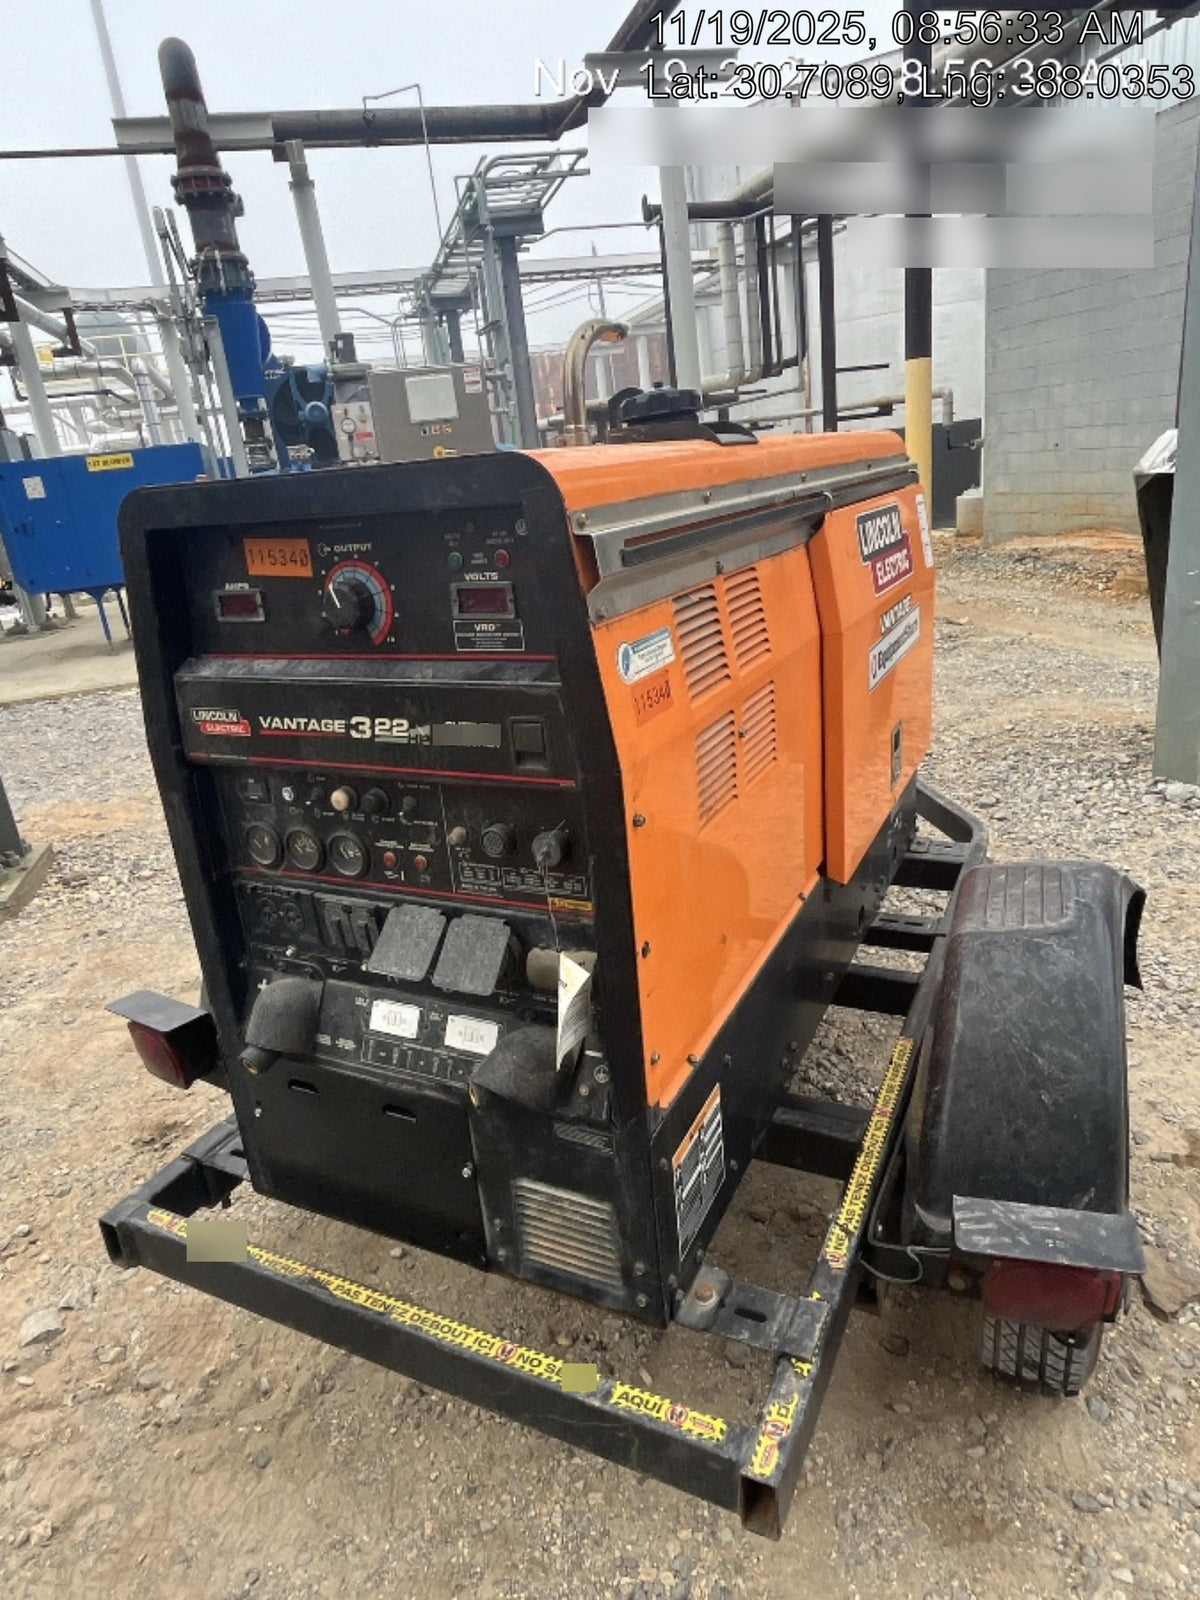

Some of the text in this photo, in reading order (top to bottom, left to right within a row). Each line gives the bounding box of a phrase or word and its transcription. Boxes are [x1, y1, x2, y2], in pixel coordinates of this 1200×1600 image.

[858, 511, 903, 556] LINCOLN
[333, 543, 373, 553] OUTPUT
[463, 572, 499, 581] VOLTS
[875, 548, 911, 586] ELECTRIC
[192, 710, 238, 722] LINCOLN
[259, 715, 346, 733] VANTAGE
[350, 715, 410, 739] 322
[334, 1279, 361, 1300] PAS
[363, 1294, 410, 1319] TENEZ
[410, 1313, 475, 1343] DEBOUT
[474, 1336, 497, 1351] ICI
[516, 1352, 543, 1369] NO
[616, 1391, 664, 1415] AQUI
